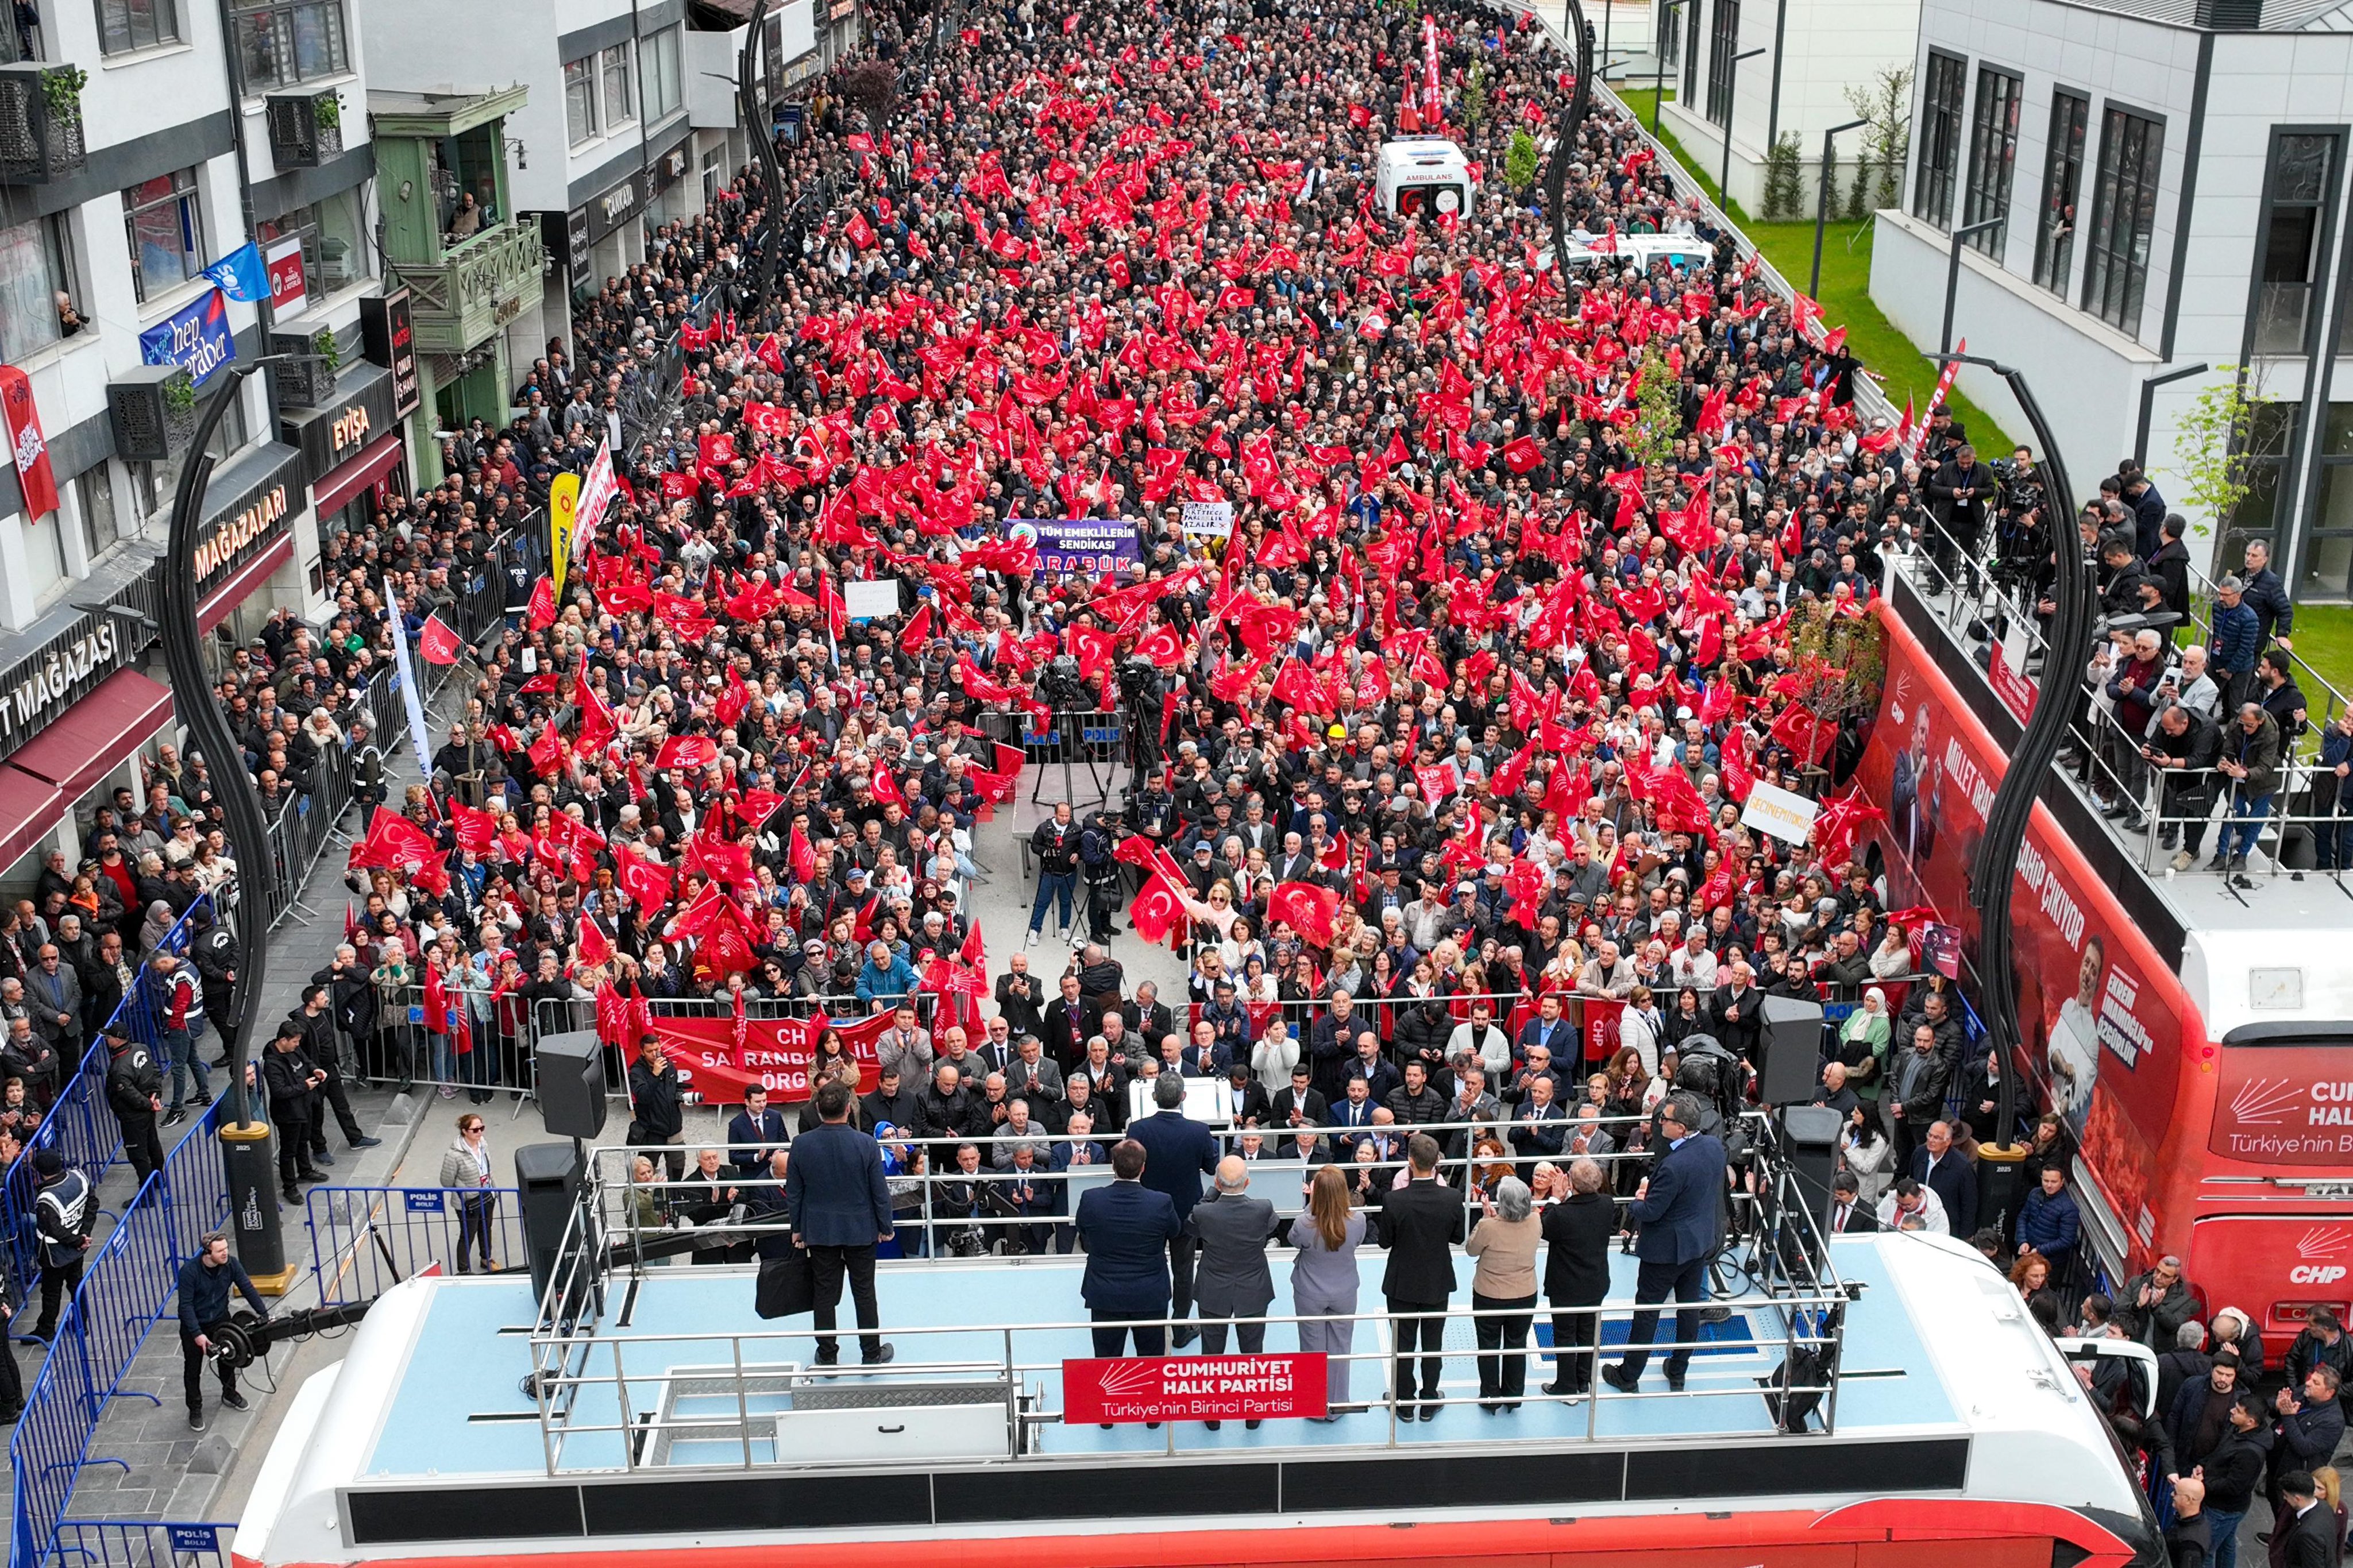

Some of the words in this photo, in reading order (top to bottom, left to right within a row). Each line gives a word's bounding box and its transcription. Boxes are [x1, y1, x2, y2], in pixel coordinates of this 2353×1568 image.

[1406, 173, 1453, 181] AMBULANS
[605, 184, 634, 225] ÇANKAYA
[169, 316, 199, 356] hep
[397, 354, 412, 376] ONUR
[333, 405, 371, 451] EYİŞA
[194, 484, 287, 583] MAĞAZALARI
[1039, 526, 1063, 537] TÜM
[1064, 526, 1135, 538] EMEKLİLERİN
[1059, 538, 1116, 550] SENDİKASI
[1032, 554, 1132, 572] ARABÜK
[13, 620, 118, 727] MAĞAZASI
[1891, 700, 1905, 725] CHP
[673, 757, 700, 765] CHP
[1945, 735, 1977, 798] MİLLET
[2040, 871, 2085, 952] ÇIKIYOR
[2106, 971, 2137, 1011] EKREM
[777, 1028, 806, 1045] CH
[1593, 1019, 1604, 1046] CHP
[2097, 1013, 2138, 1068] ÖZGÜRLÜK
[2228, 1133, 2333, 1157] Türkiye'nin
[410, 1192, 438, 1200] POLİS
[2290, 1265, 2347, 1284] CHP
[1162, 1357, 1293, 1378] CUMHURİYET
[1163, 1380, 1216, 1395] HALK
[1220, 1374, 1293, 1393] PARTİSİ
[1101, 1400, 1187, 1419] Türkiye'nin
[1191, 1400, 1240, 1415] Birinci
[1244, 1397, 1293, 1412] Partisi
[176, 1530, 211, 1539] POLİS
